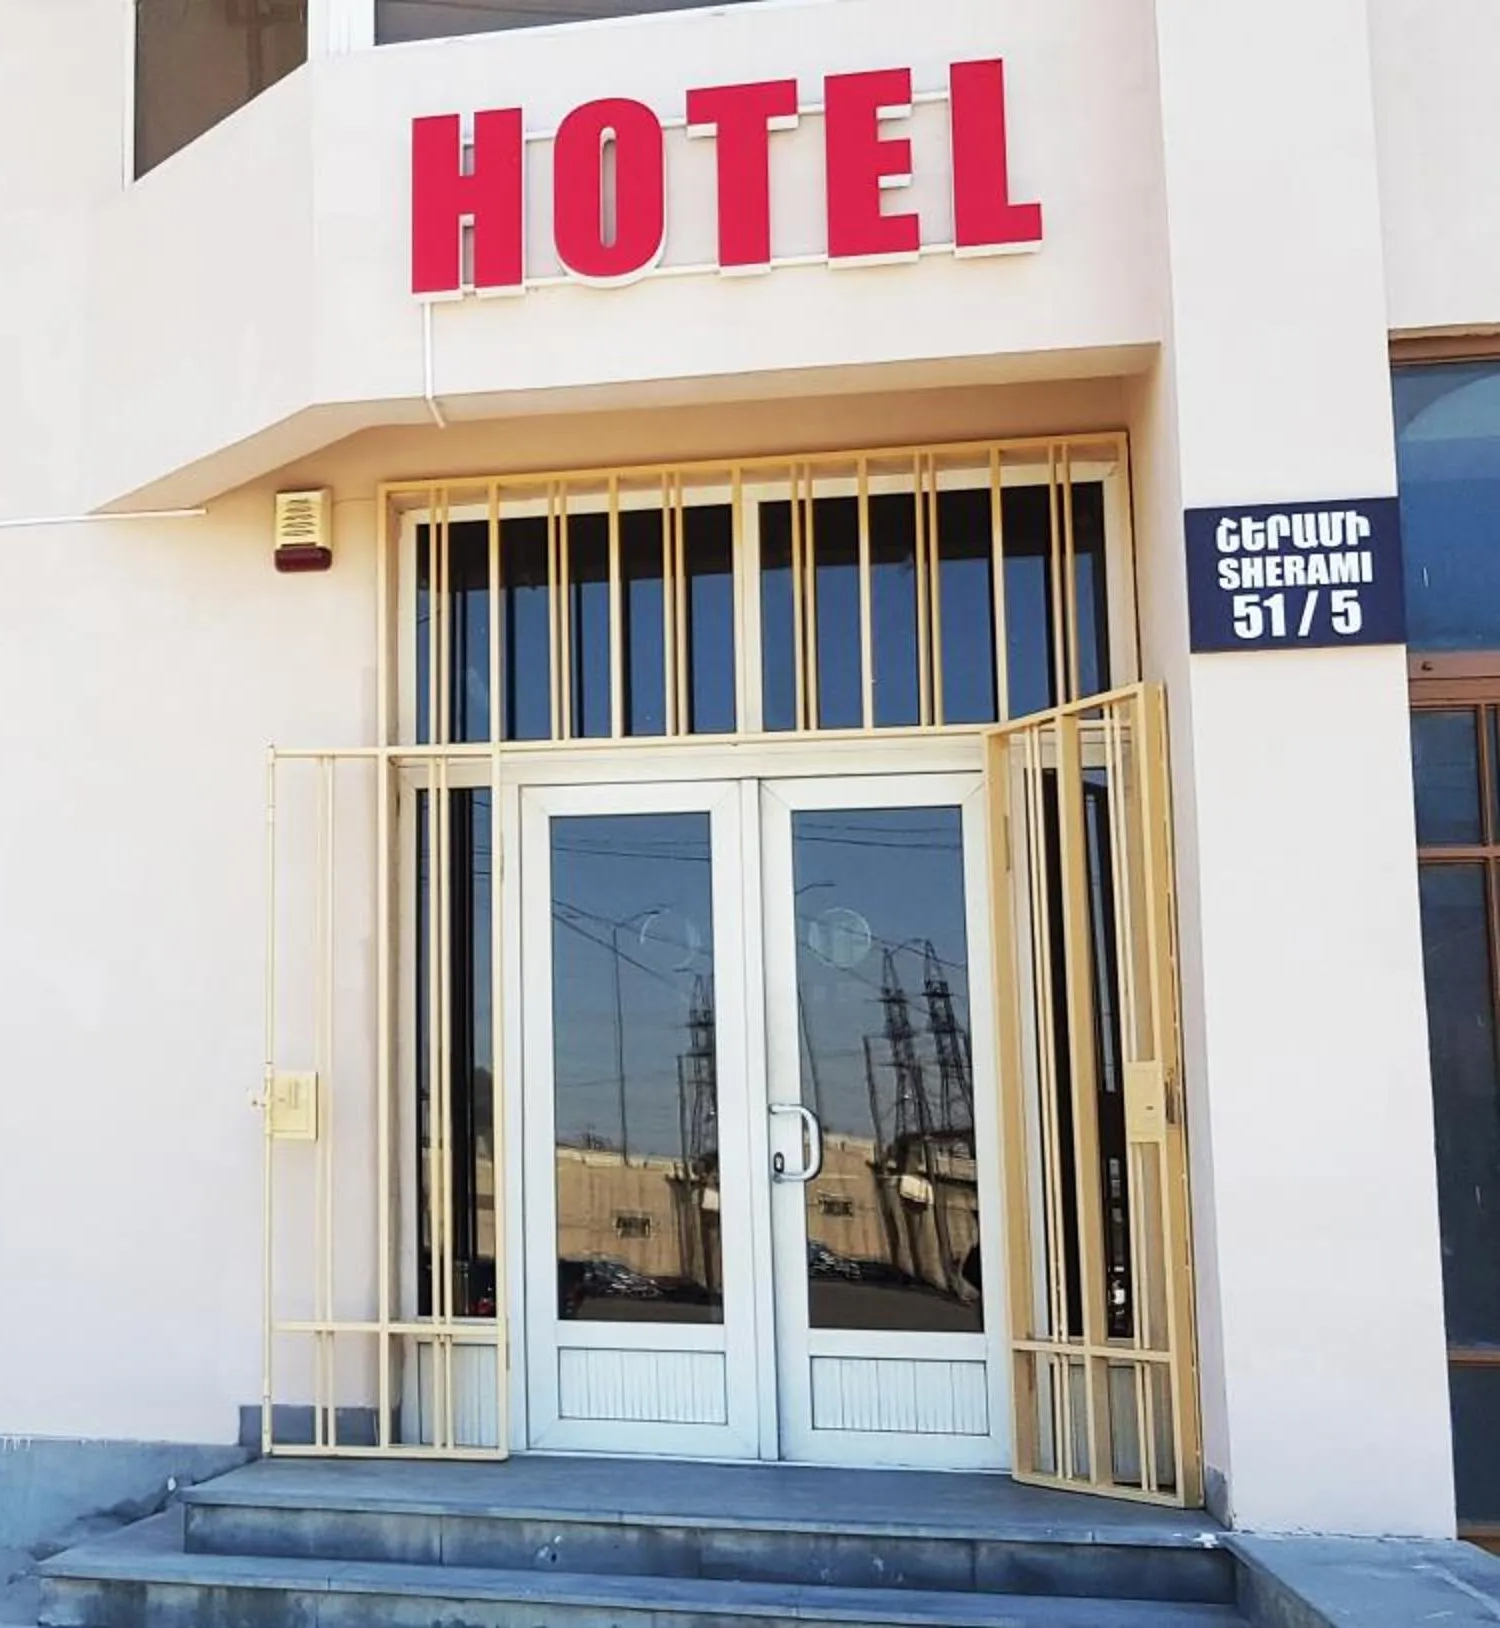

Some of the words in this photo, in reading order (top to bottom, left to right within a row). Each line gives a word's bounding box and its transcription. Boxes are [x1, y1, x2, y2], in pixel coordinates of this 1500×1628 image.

[411, 58, 1043, 300] HOTEL
[1215, 510, 1371, 553] ՇԵՐԱՄԻ
[1217, 551, 1373, 590] SHERAMI
